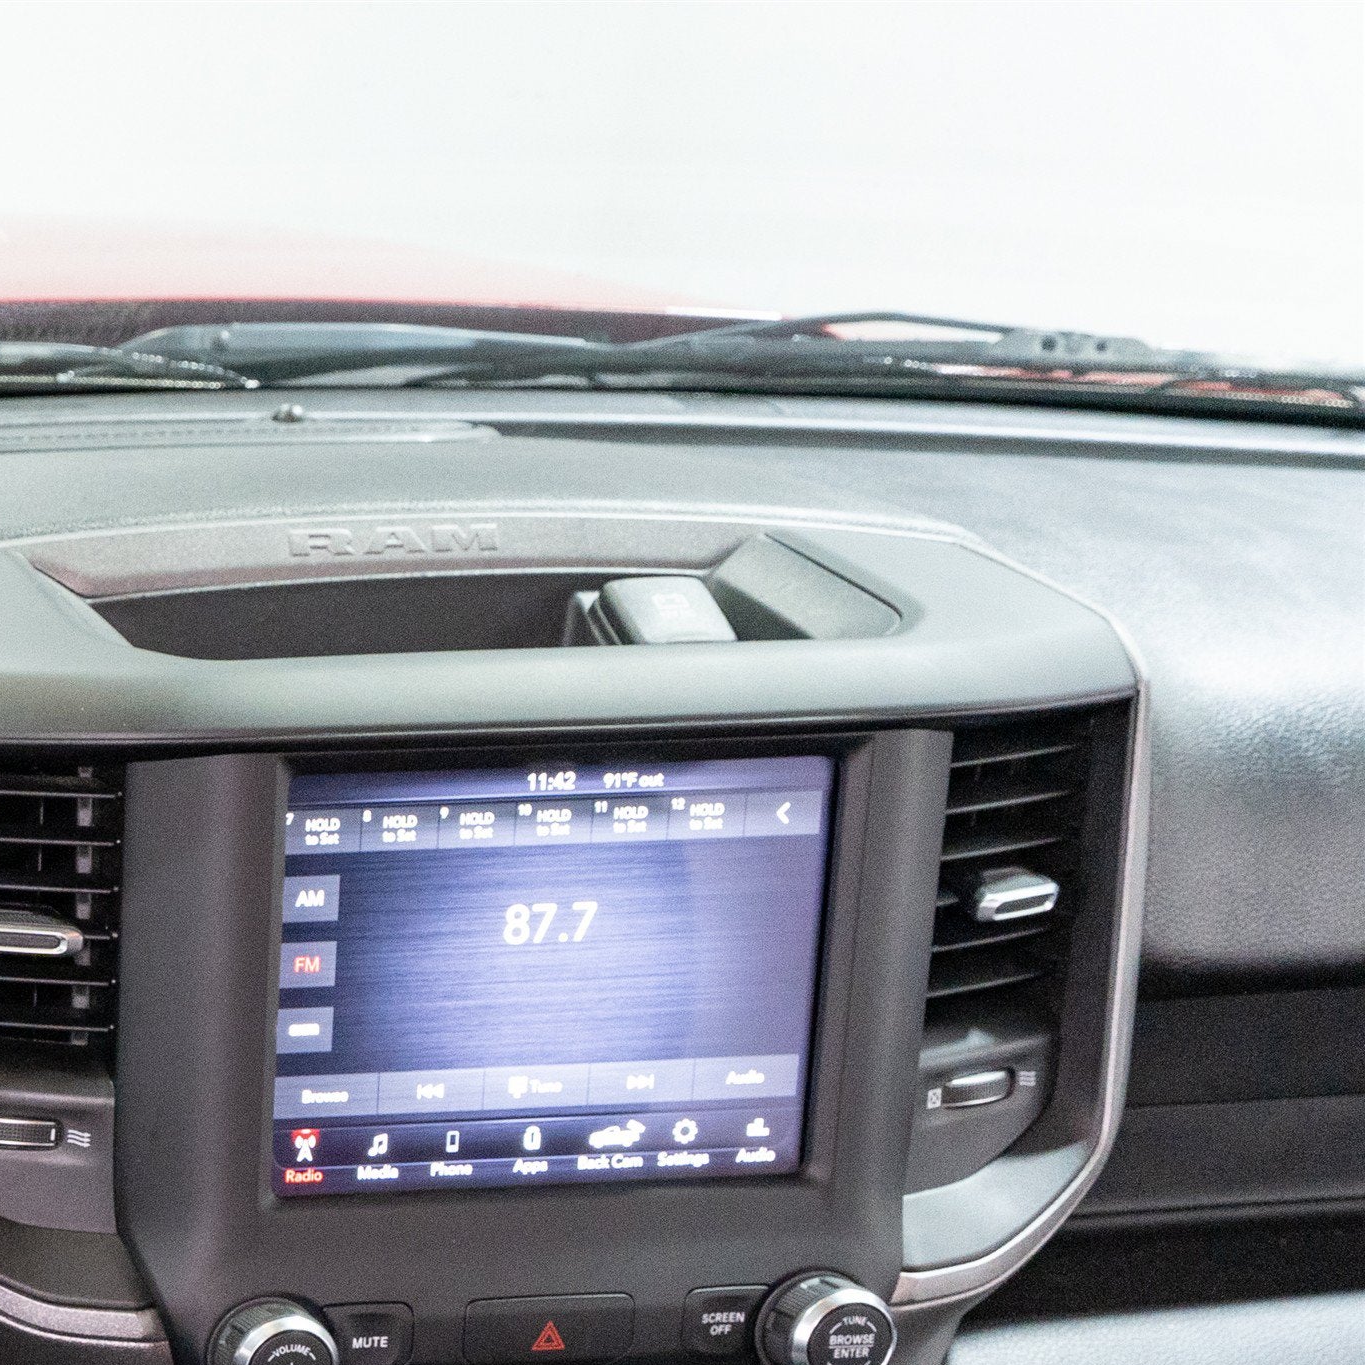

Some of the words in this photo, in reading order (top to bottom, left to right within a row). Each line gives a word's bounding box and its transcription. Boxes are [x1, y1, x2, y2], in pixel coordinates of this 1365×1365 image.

[287, 523, 499, 557] RAM
[527, 771, 576, 792] 11:42
[638, 773, 665, 788] out
[594, 800, 608, 813] 11
[671, 797, 685, 810] 12
[690, 803, 726, 817] HOLD
[285, 812, 295, 826] 7
[362, 809, 372, 823] 8
[439, 806, 450, 819] 9
[460, 812, 496, 826] HOLD
[537, 808, 573, 822] HOLD
[614, 806, 650, 820] HOLD
[305, 818, 341, 832] HOLD
[383, 815, 419, 829] HOLD
[294, 889, 325, 908] AM
[502, 900, 599, 946] 87.7
[293, 955, 321, 974] FM
[725, 1069, 765, 1086] Audio
[577, 1153, 611, 1171] Back
[610, 1153, 644, 1170] Cam
[657, 1151, 710, 1168] Settings
[735, 1146, 776, 1164] Audio
[357, 1163, 400, 1181] Media
[429, 1160, 474, 1178] Phone
[512, 1157, 549, 1176] Apps
[285, 1168, 324, 1184] Radio
[701, 1312, 746, 1324] SCREEN
[842, 1315, 869, 1327] TUNE
[709, 1324, 732, 1336] OFF
[352, 1336, 389, 1349] MUTE
[829, 1334, 876, 1346] BROWSE
[272, 1343, 311, 1358] VOLUME
[833, 1346, 870, 1359] ENTER
